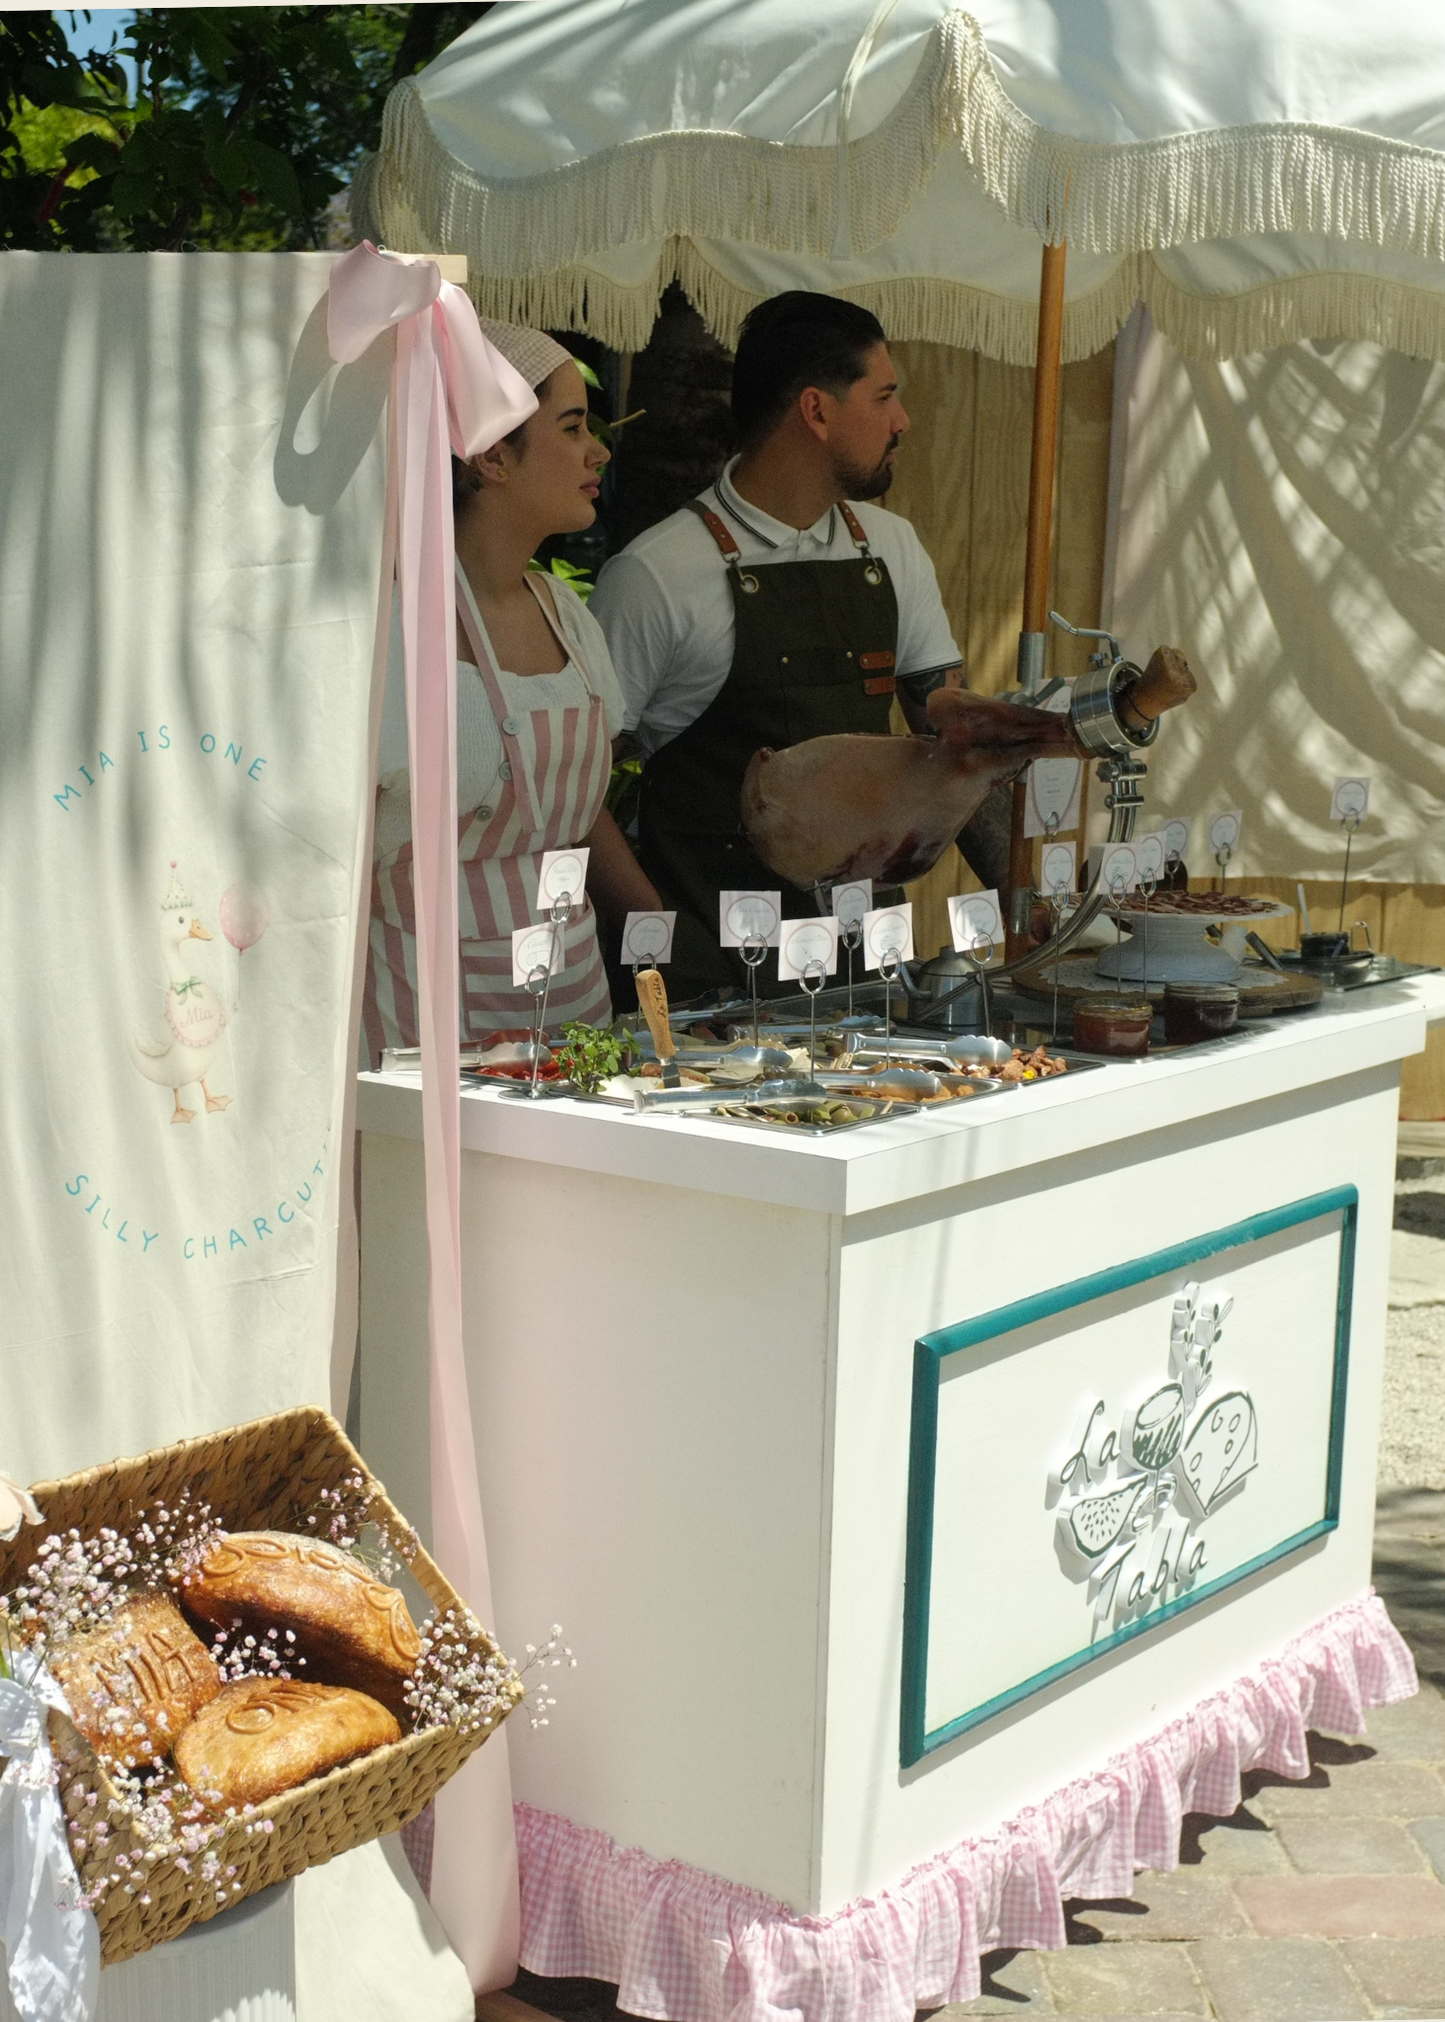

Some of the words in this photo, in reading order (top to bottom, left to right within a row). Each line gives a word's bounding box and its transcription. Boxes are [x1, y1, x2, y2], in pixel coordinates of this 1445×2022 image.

[53, 751, 115, 812] MIA
[137, 724, 171, 753] IS
[199, 733, 268, 782] ONE
[180, 1006, 214, 1028] Mia
[653, 976, 663, 1003] Tabla
[65, 1174, 159, 1252] SILLY
[183, 1119, 332, 1259] CHARCUT
[1060, 1399, 1120, 1485] La
[1101, 1522, 1207, 1620] Tabla
